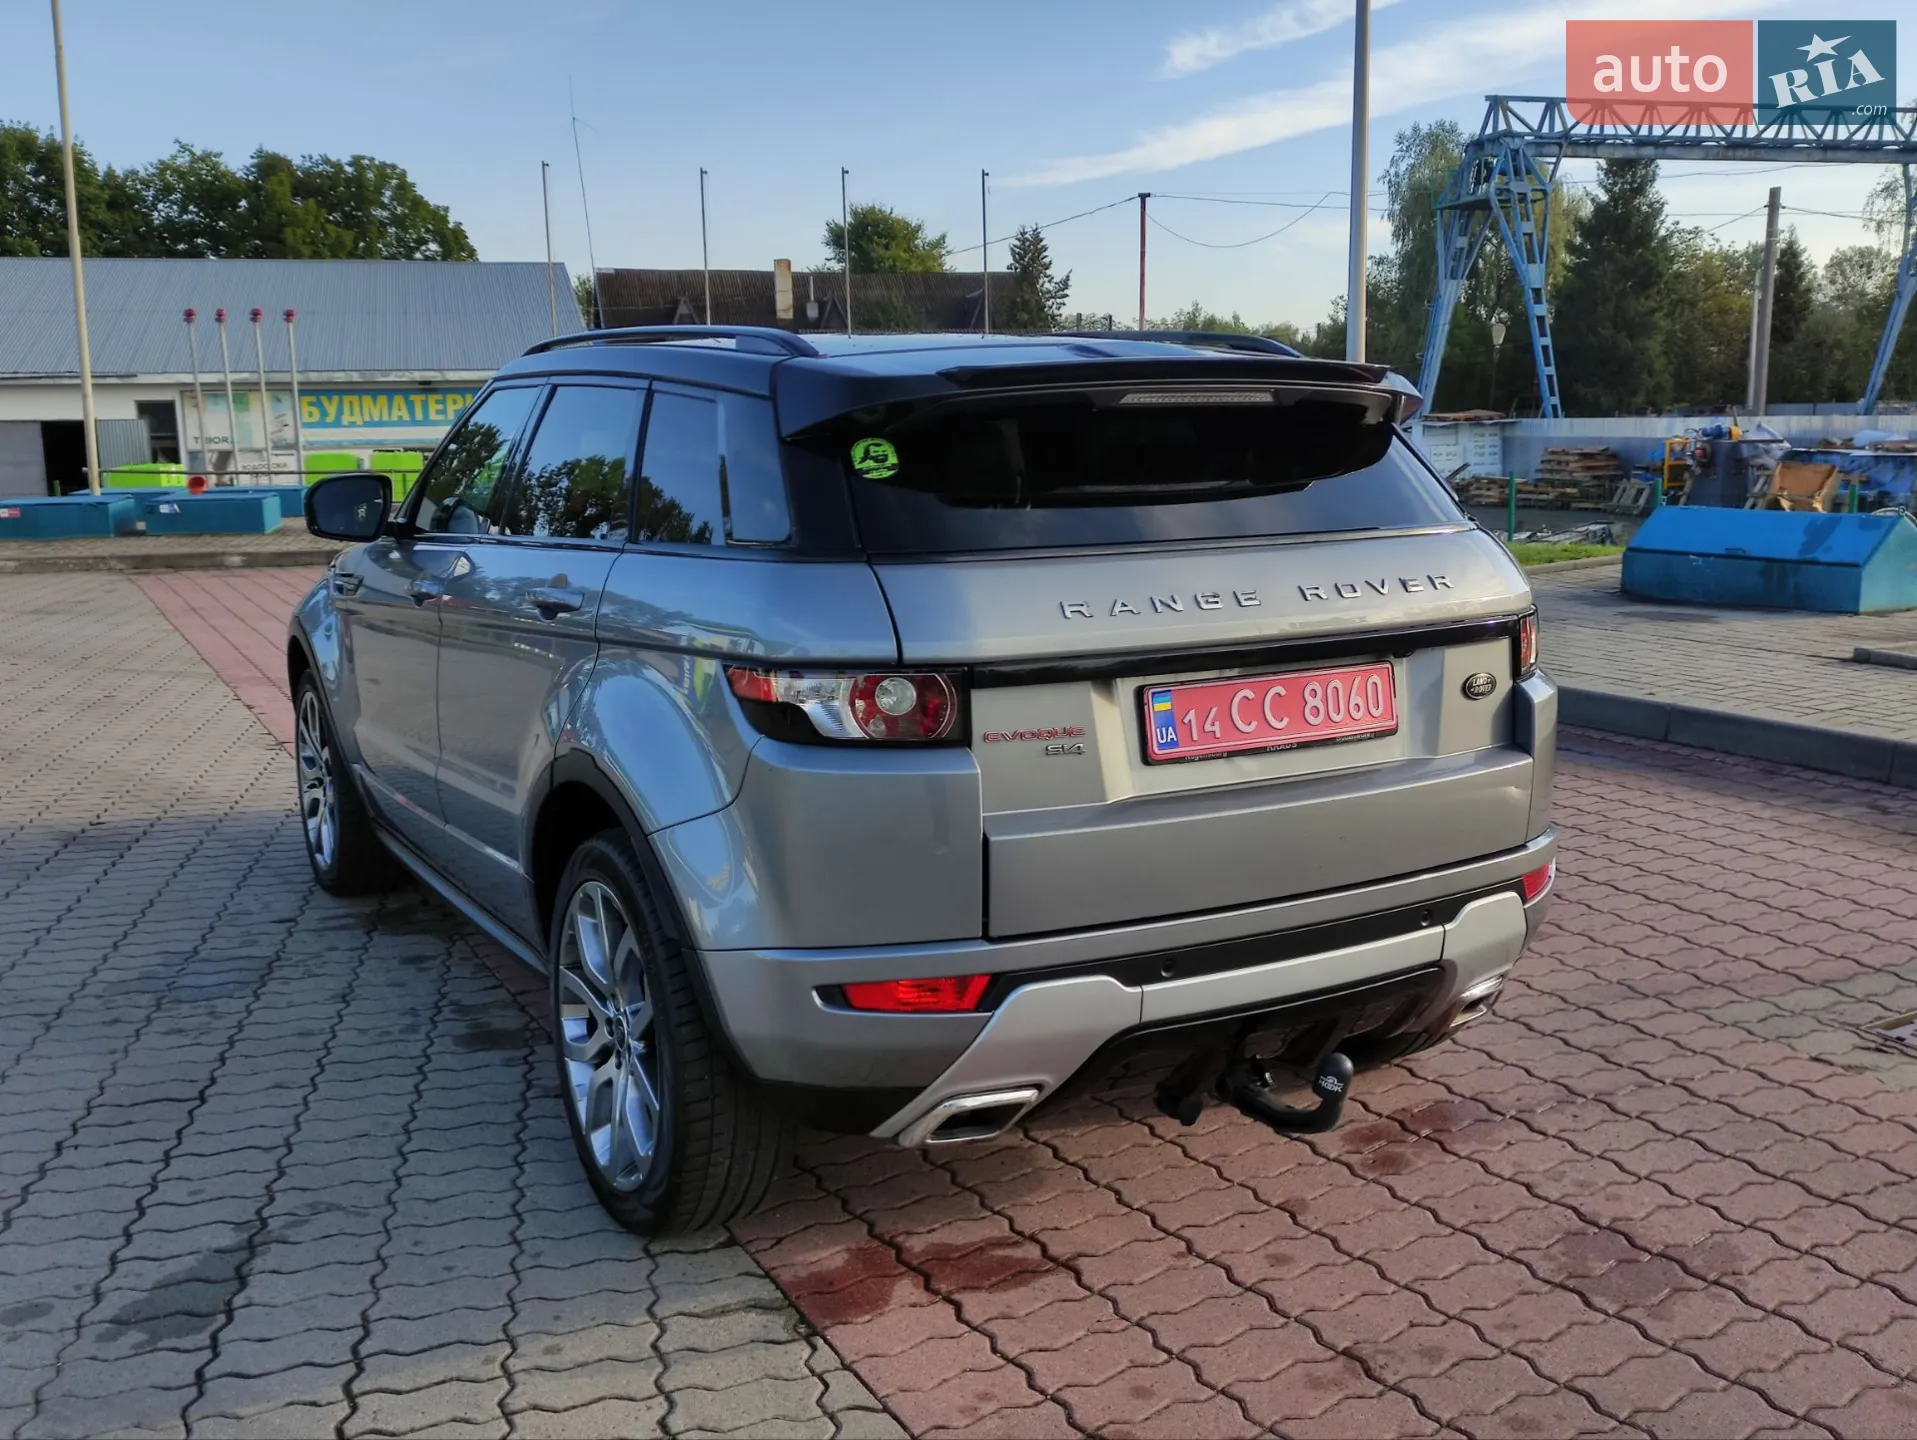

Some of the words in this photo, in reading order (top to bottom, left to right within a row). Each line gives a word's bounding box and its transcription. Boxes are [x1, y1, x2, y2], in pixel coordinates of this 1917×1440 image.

[1060, 589, 1262, 620] RANGE
[1298, 573, 1455, 602] ROVER
[1182, 706, 1221, 742] 14
[1230, 685, 1291, 734] CC
[1303, 673, 1384, 726] 8060
[984, 725, 1086, 743] EVOQUE
[1156, 725, 1178, 744] UA
